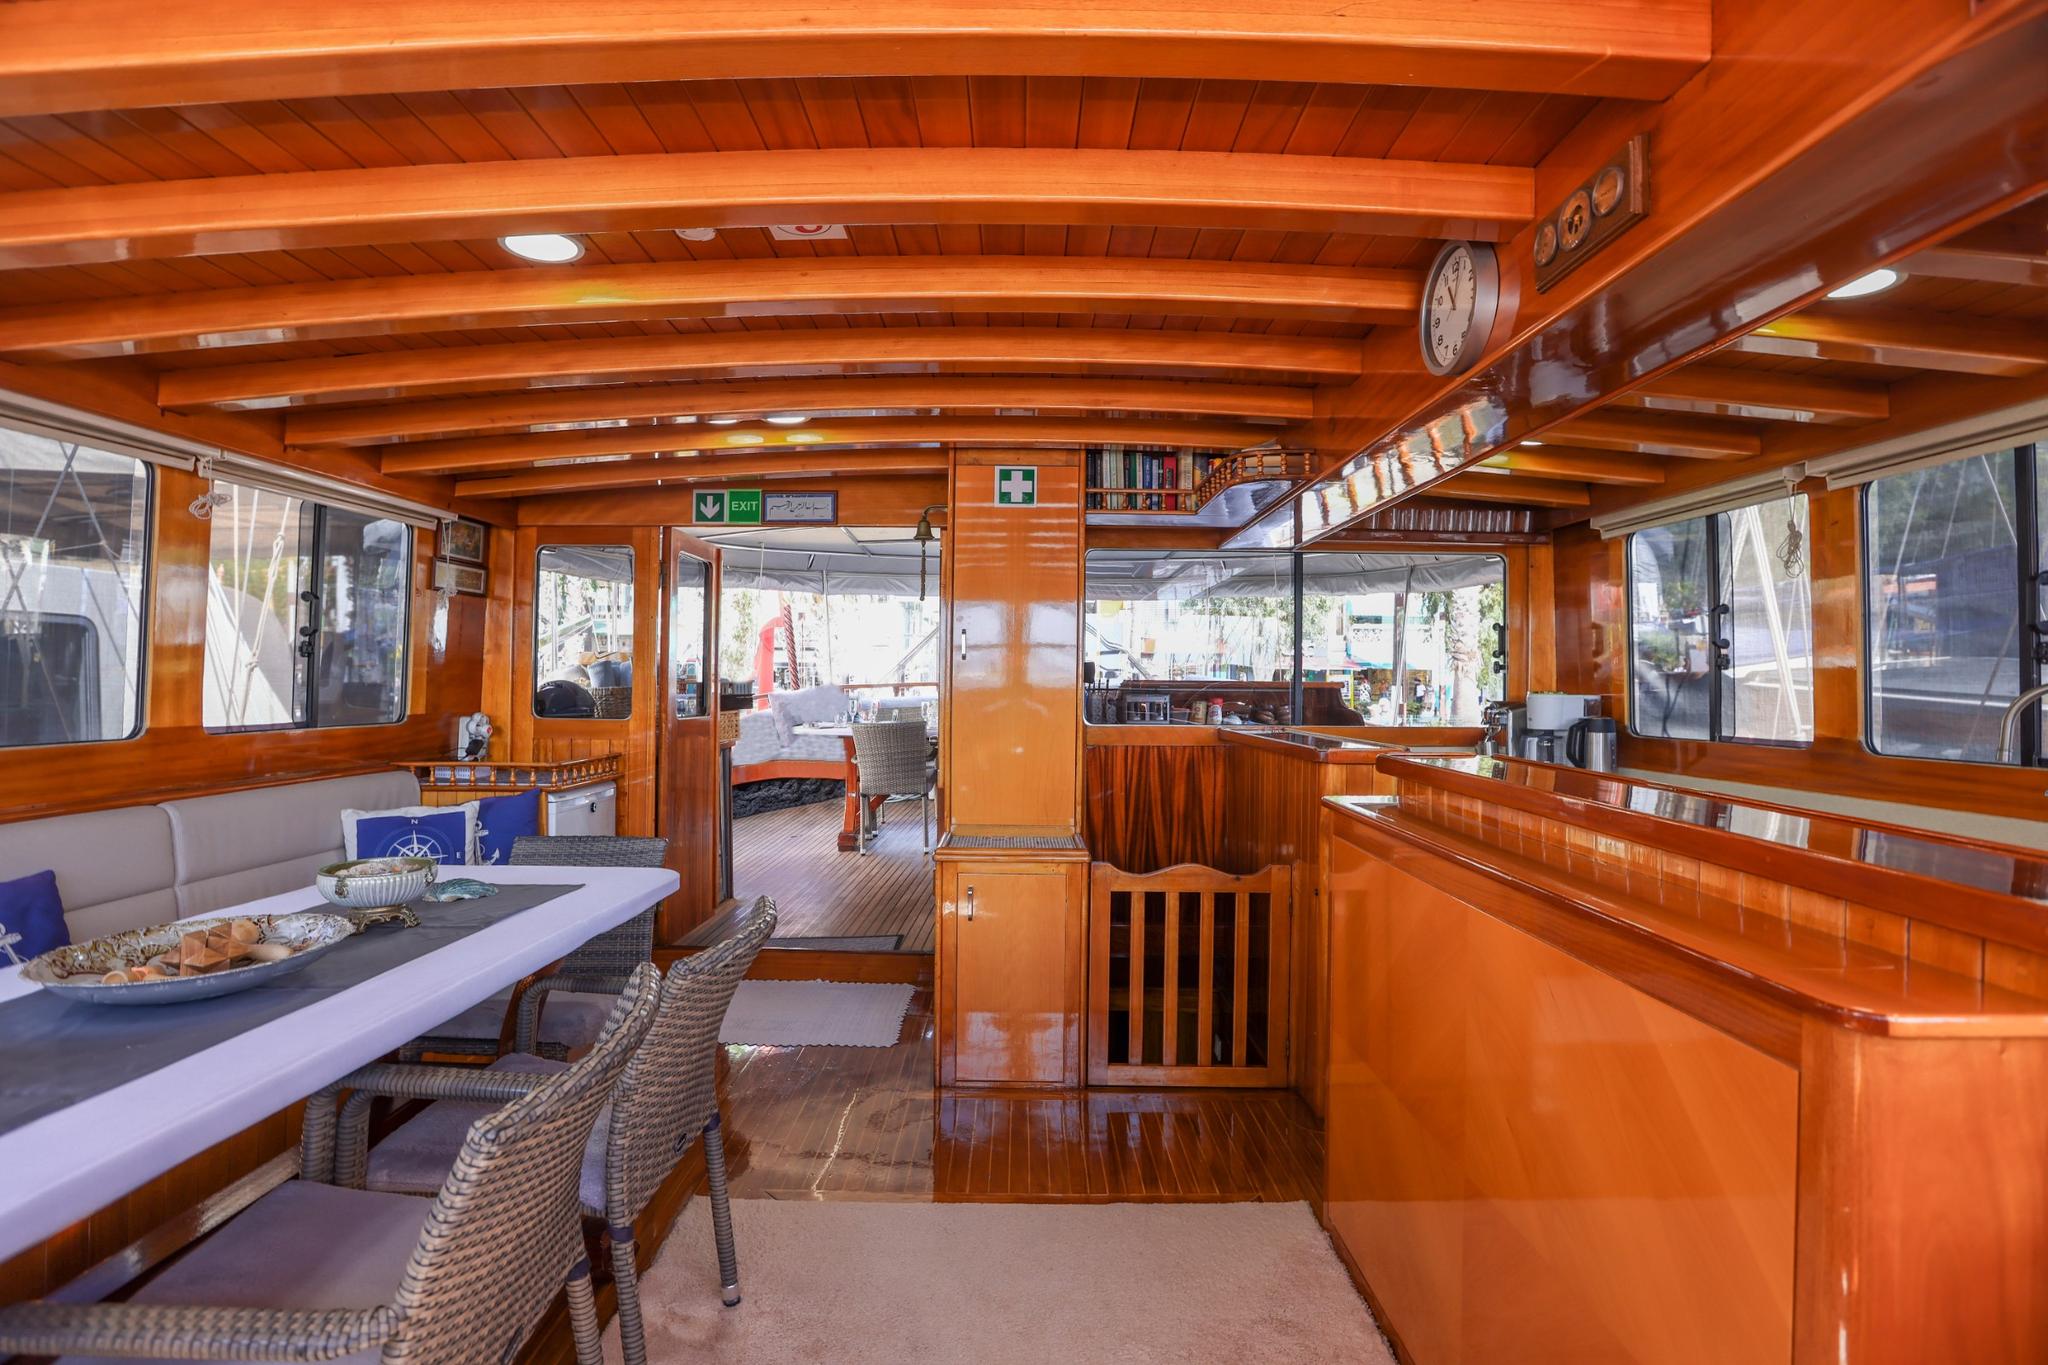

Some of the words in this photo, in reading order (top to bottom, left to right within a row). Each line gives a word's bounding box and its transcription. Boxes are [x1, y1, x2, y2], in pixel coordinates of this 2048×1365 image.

[1435, 295, 1444, 309] 10
[1435, 317, 1441, 329] 9
[1437, 334, 1443, 346] 8
[731, 501, 758, 511] EXIT
